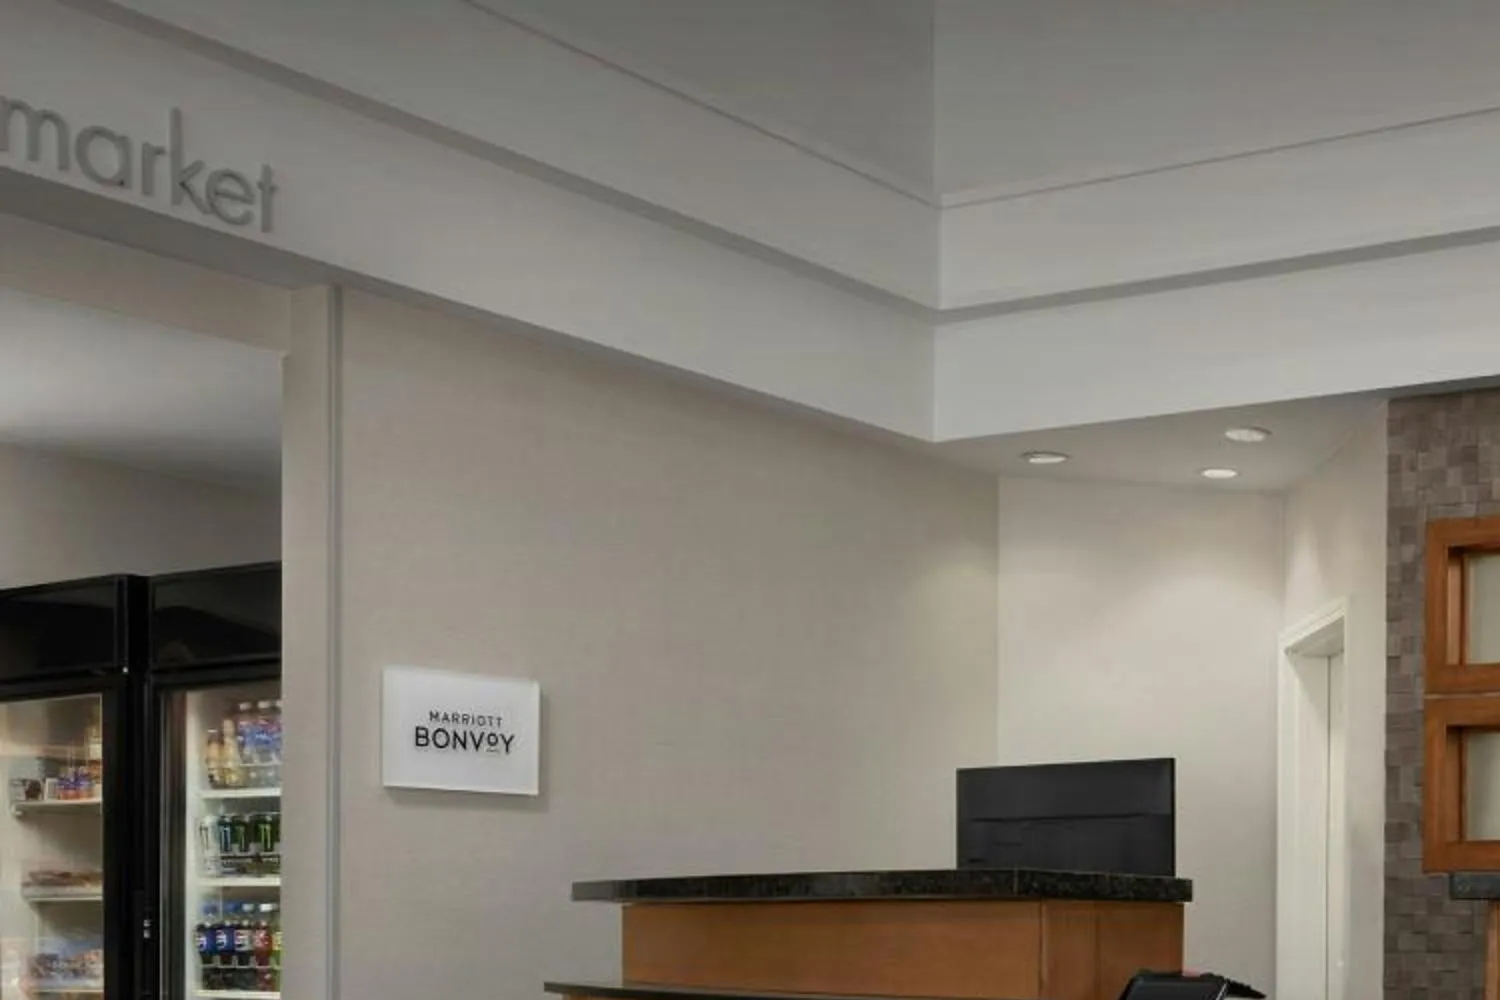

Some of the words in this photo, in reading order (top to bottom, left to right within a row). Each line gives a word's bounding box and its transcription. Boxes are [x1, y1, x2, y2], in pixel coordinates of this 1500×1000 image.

[0, 95, 278, 233] market
[429, 710, 503, 728] MARRIOTT
[415, 725, 515, 755] BONVOY
